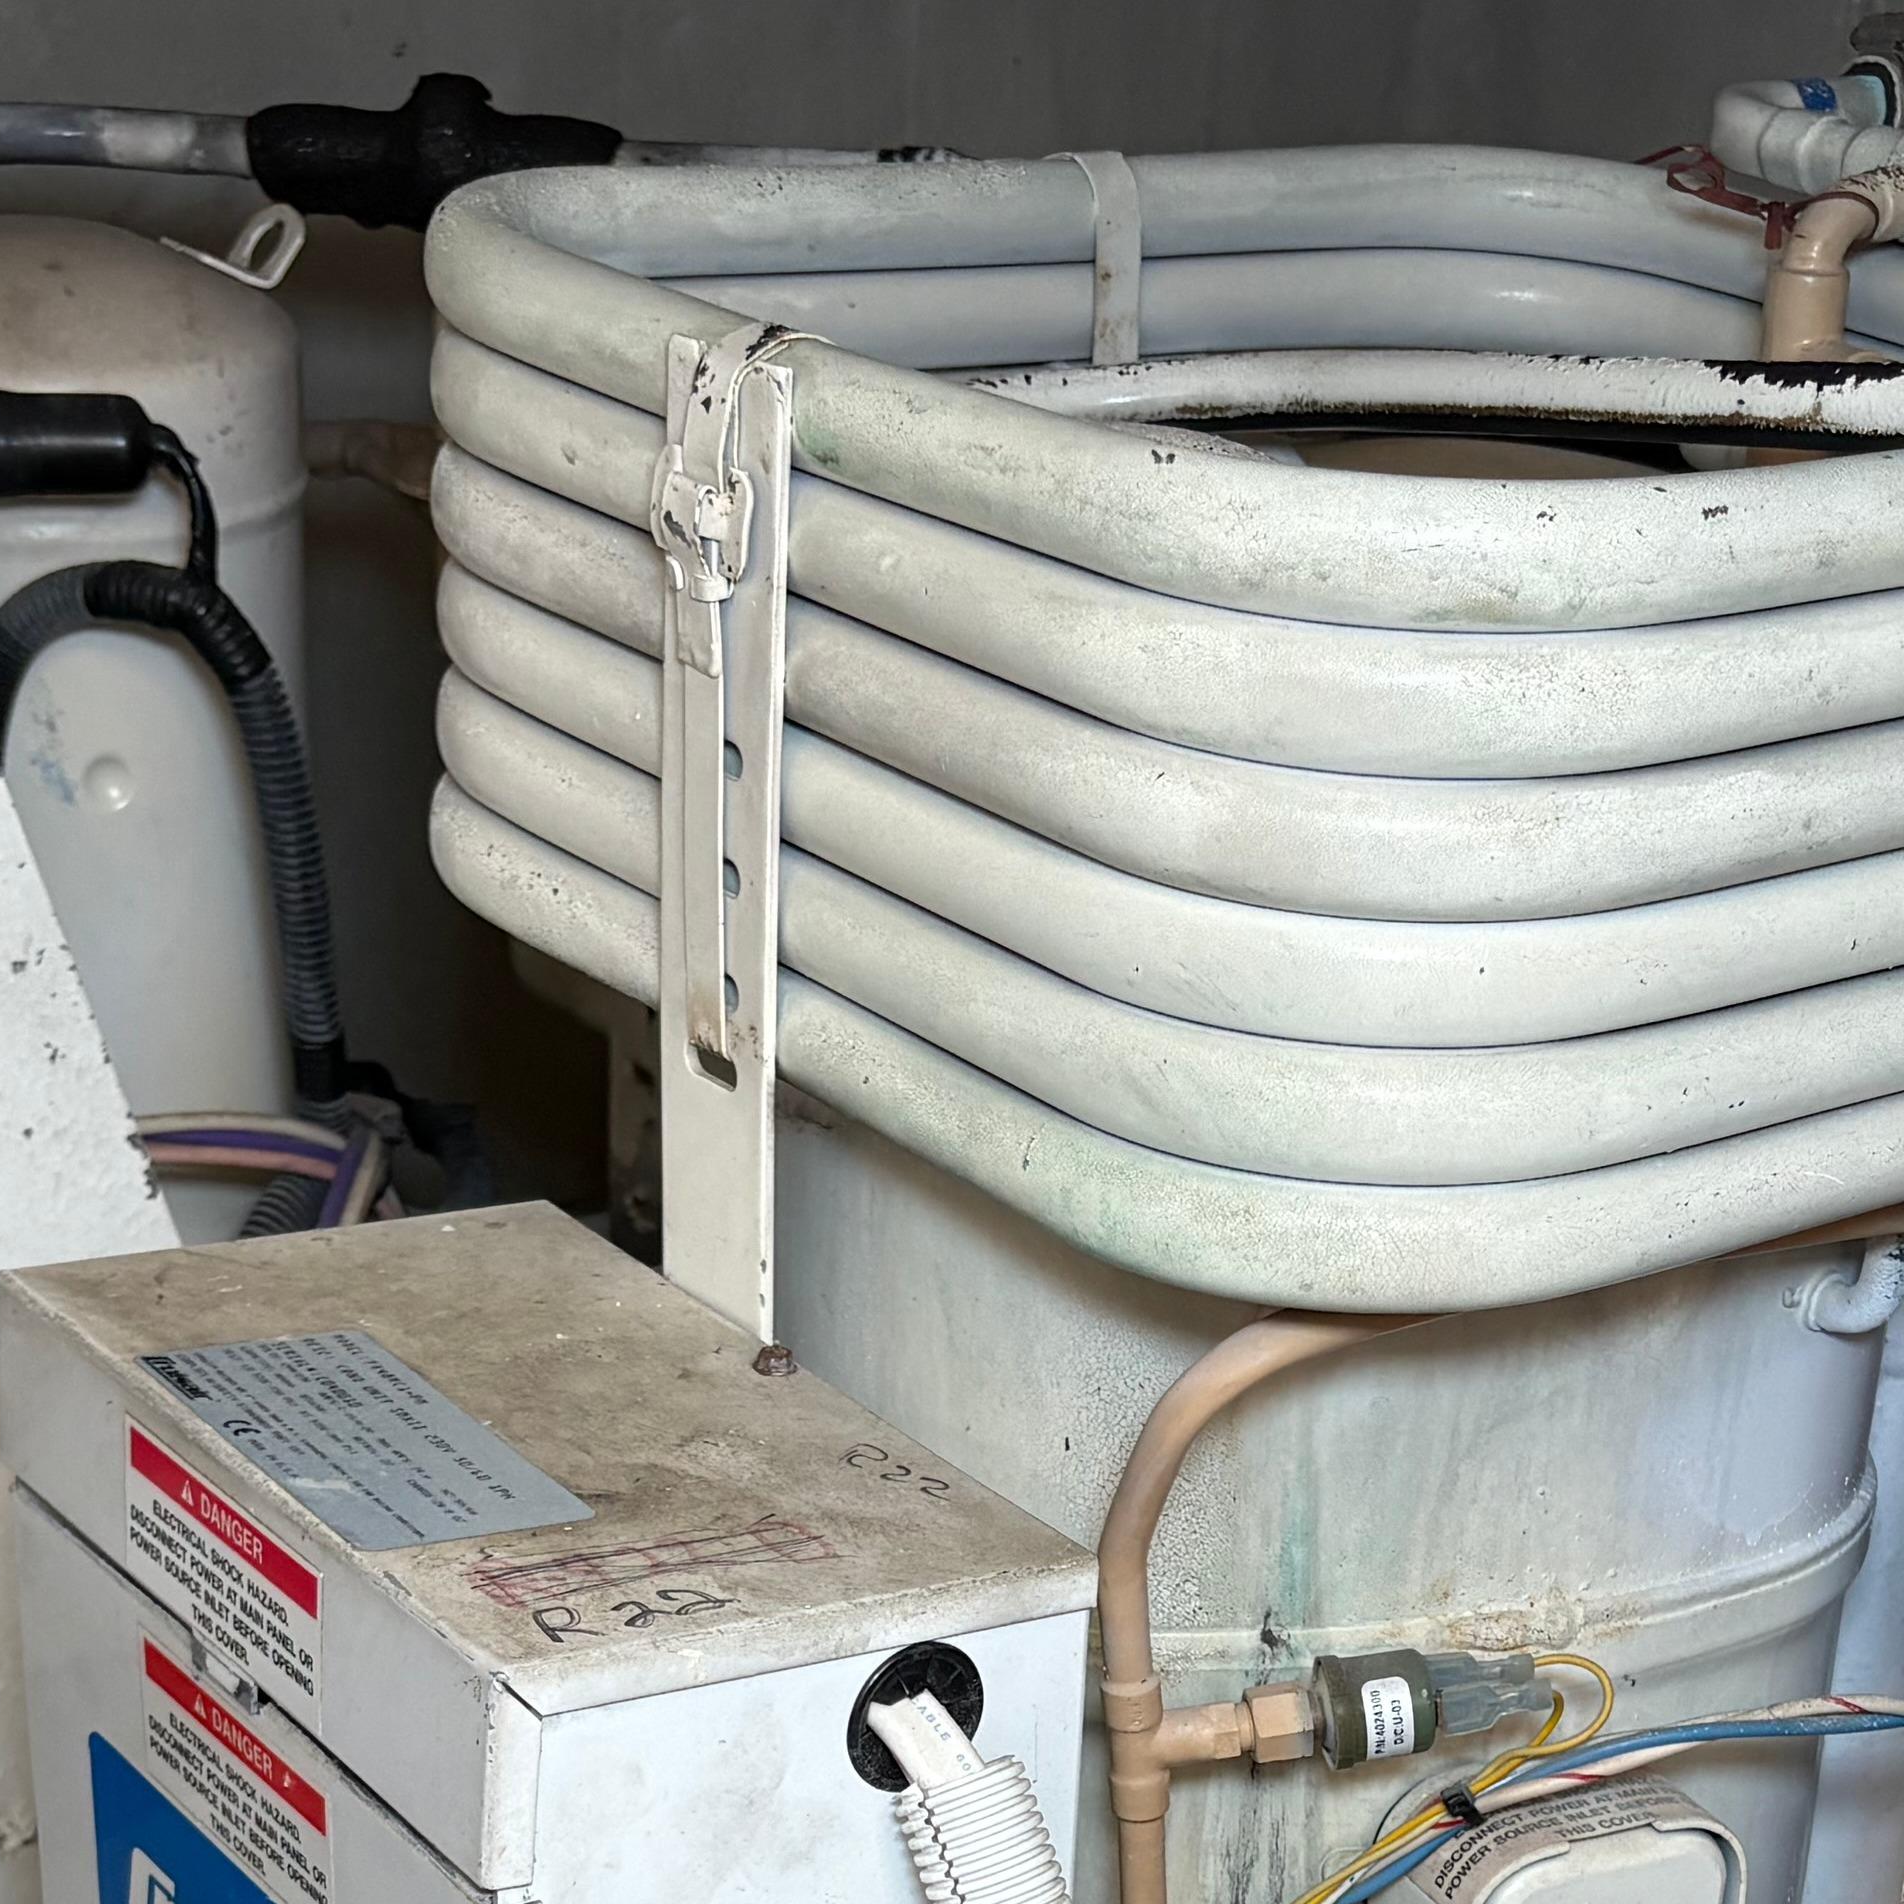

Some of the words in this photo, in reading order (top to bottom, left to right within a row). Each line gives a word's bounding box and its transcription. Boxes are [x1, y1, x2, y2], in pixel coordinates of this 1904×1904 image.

[152, 1499, 209, 1559] ELECTRICAL
[210, 1548, 244, 1589] SHOCK
[247, 1578, 289, 1627] HAZARD.
[200, 1492, 263, 1565] DANGER
[129, 1526, 162, 1566] POWER
[164, 1555, 202, 1600] SOURCE
[203, 1589, 230, 1623] INLET
[232, 1613, 269, 1658] BEFORE
[271, 1648, 314, 1697] OPENING
[130, 1504, 187, 1564] DISCONNECT
[190, 1554, 224, 1596] POWER
[225, 1586, 238, 1606] AT
[239, 1596, 264, 1630] MAIN
[266, 1619, 297, 1658] PANEL
[298, 1648, 314, 1673] OR
[191, 1603, 214, 1635] THIS
[214, 1624, 250, 1666] COVER.
[212, 1707, 273, 1780] DANGER
